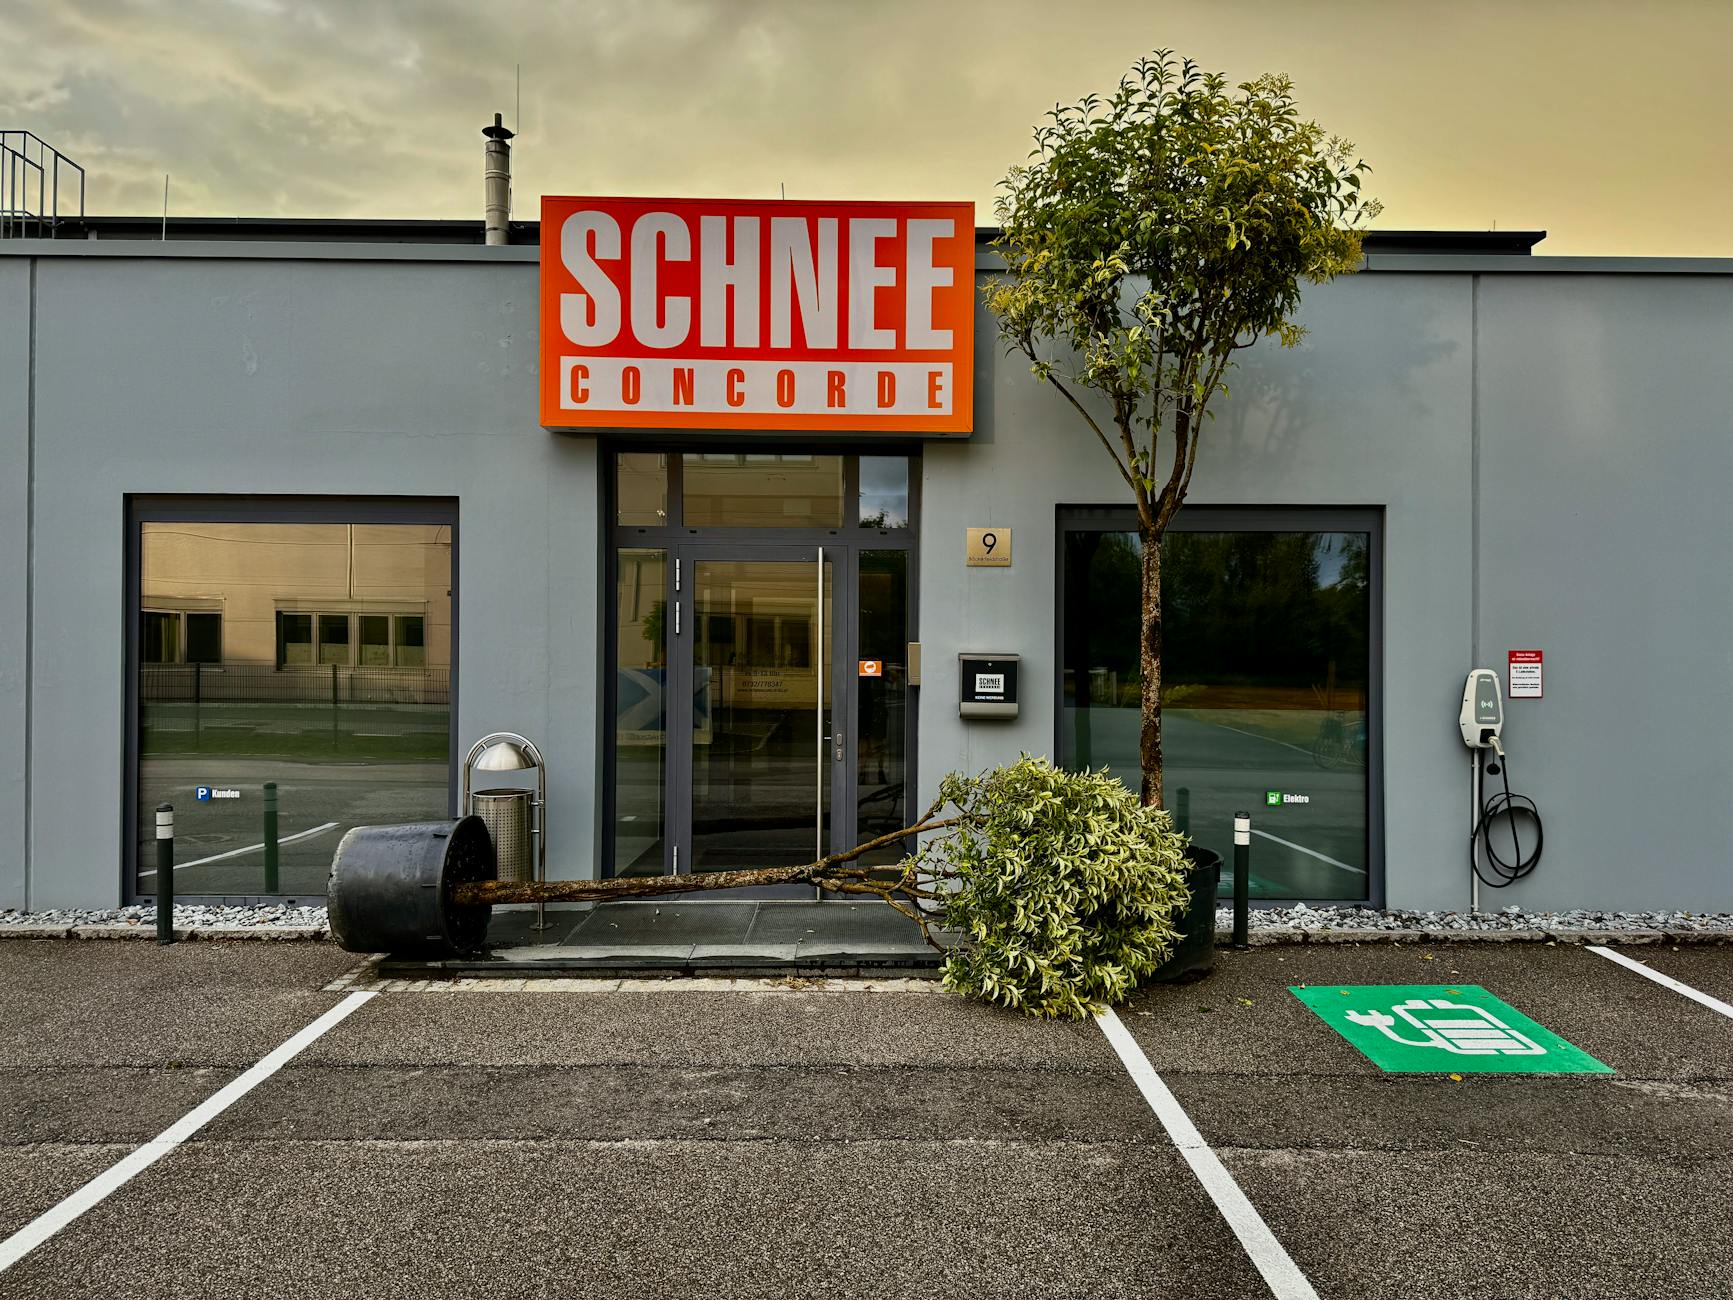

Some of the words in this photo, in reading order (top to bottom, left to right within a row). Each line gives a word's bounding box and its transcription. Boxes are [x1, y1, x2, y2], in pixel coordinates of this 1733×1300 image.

[559, 209, 955, 350] SCHNEE
[570, 364, 943, 409] CONCORDE
[982, 532, 997, 555] 9
[978, 677, 1001, 686] SCHNEE
[211, 788, 240, 799] Kunden
[1282, 793, 1310, 803] Elektro
